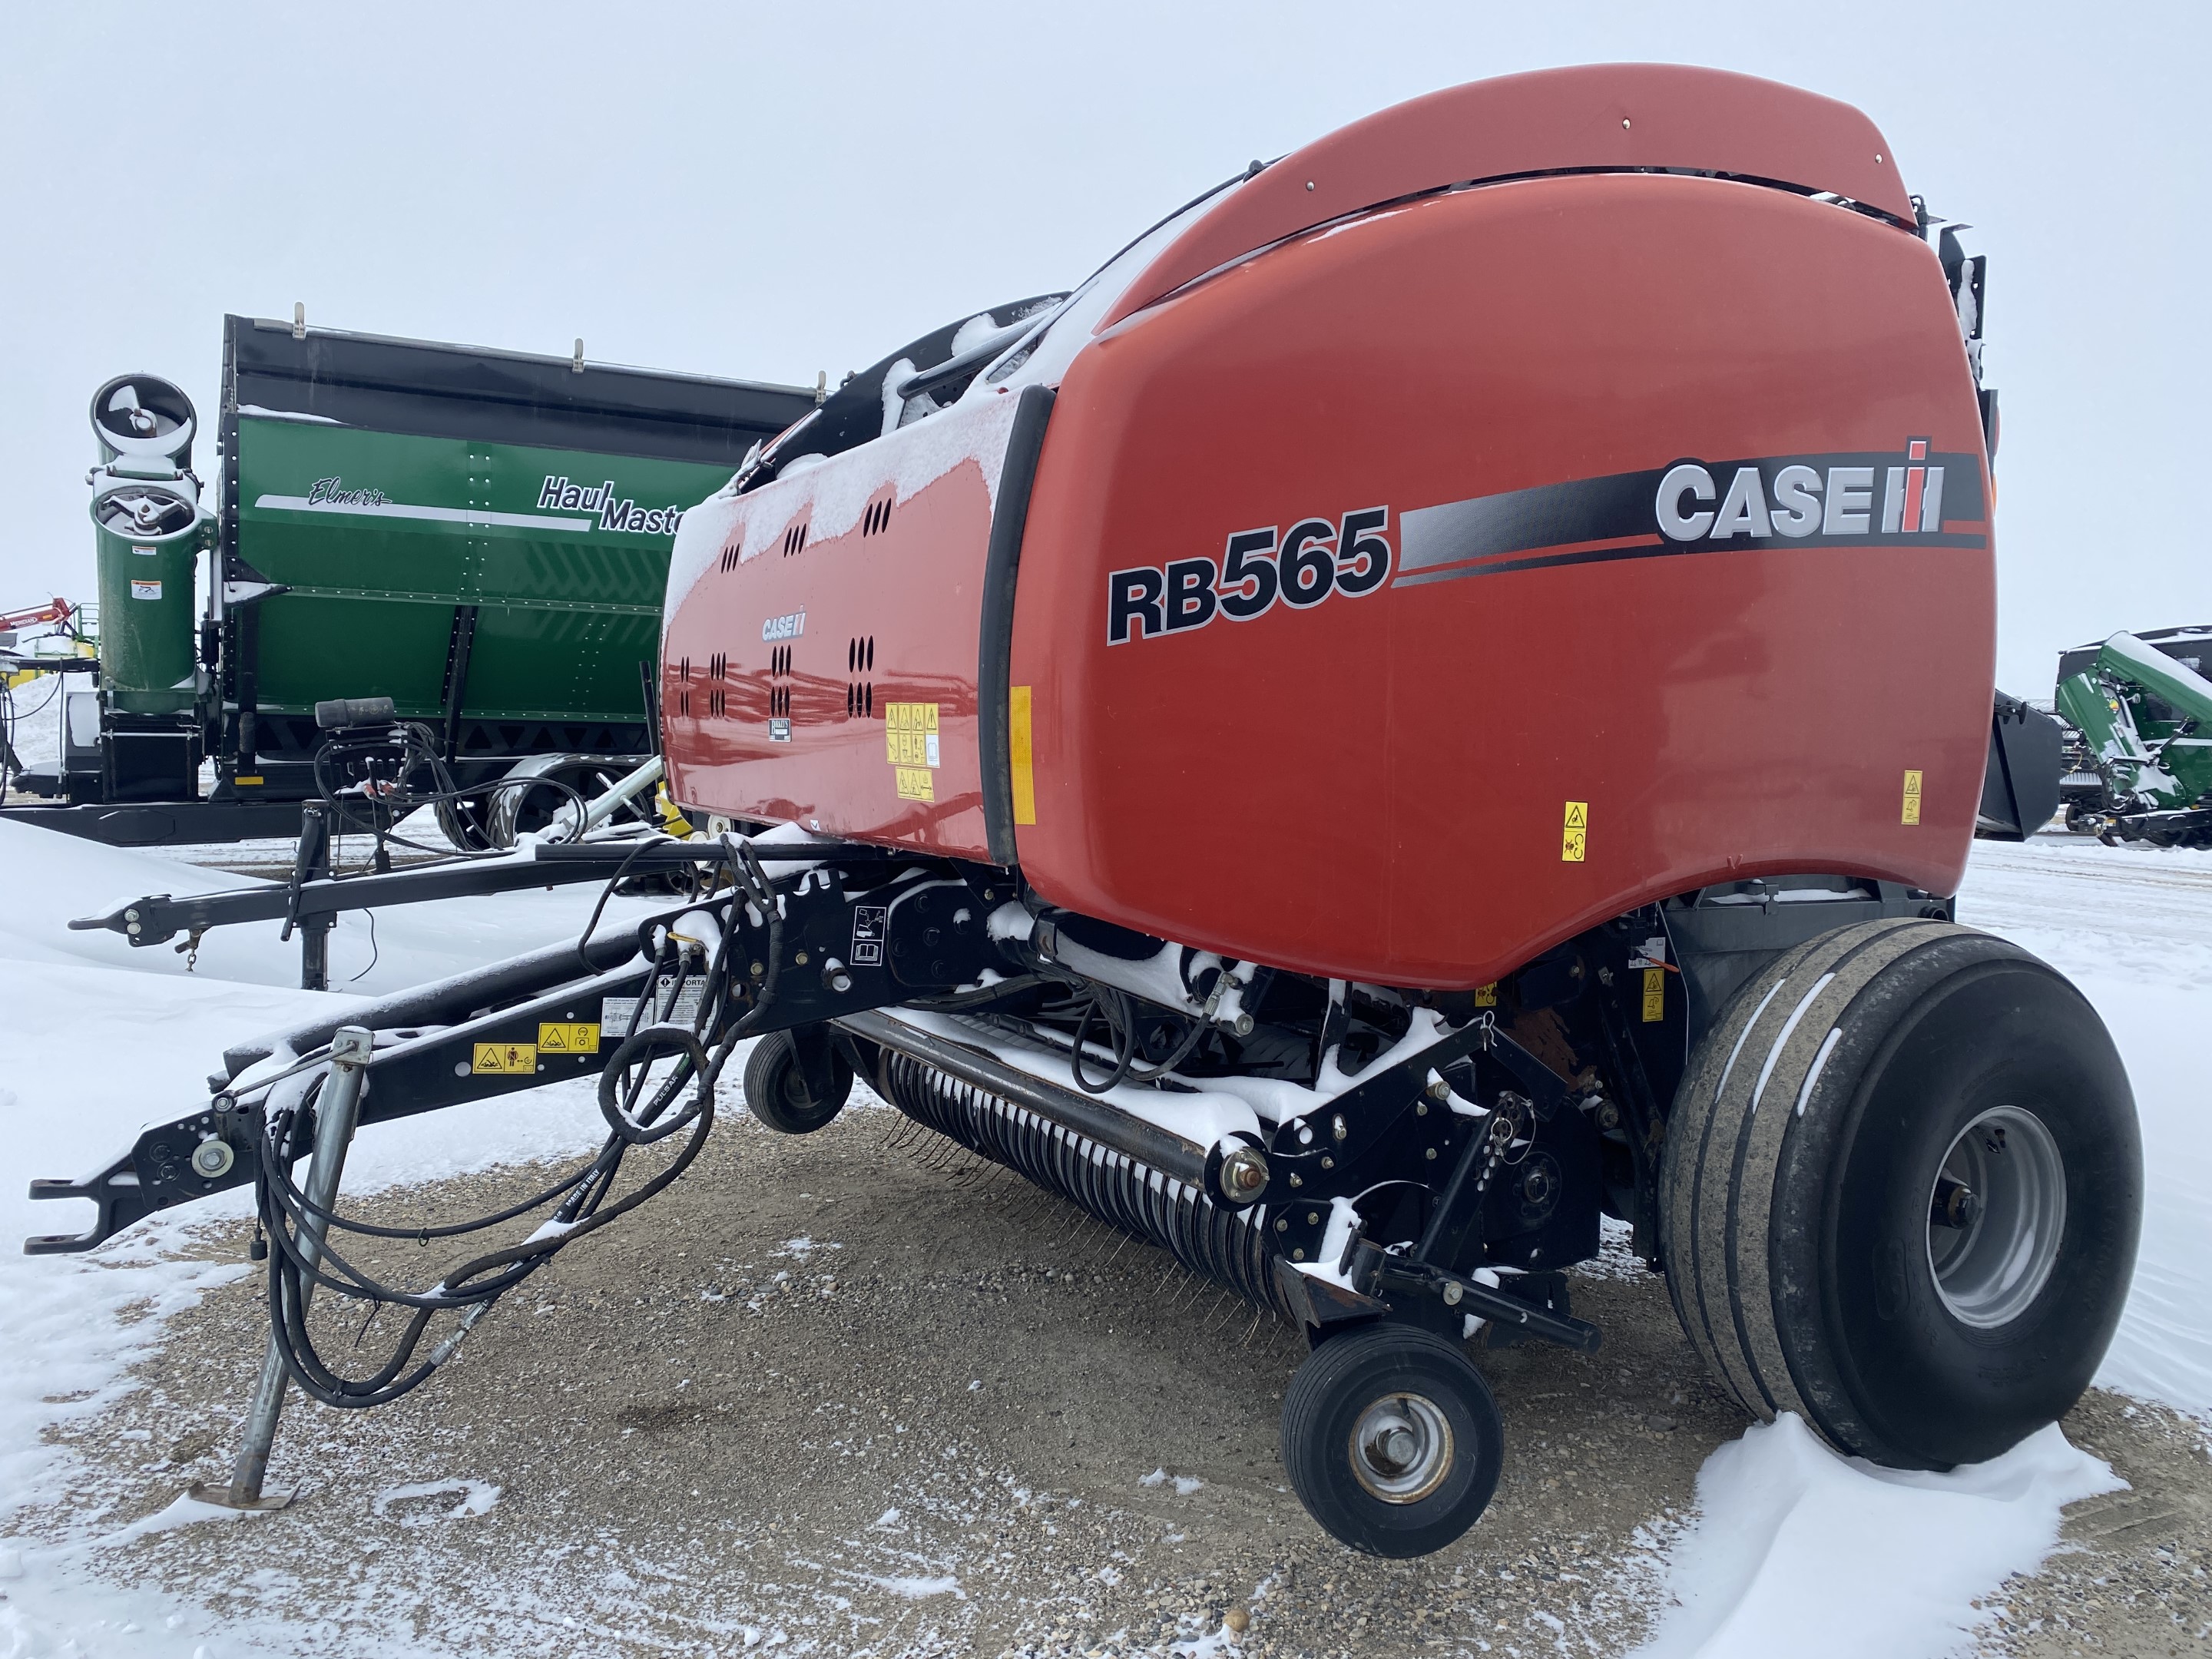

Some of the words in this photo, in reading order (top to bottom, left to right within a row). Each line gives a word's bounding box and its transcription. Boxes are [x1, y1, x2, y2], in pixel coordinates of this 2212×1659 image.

[309, 476, 392, 506] Elmer's
[537, 475, 614, 512] Haul
[598, 498, 687, 535] Maste
[1107, 505, 1392, 646] RB565
[565, 1190, 582, 1208] MADE
[579, 1182, 588, 1192] IN
[585, 1168, 600, 1184] ITALY
